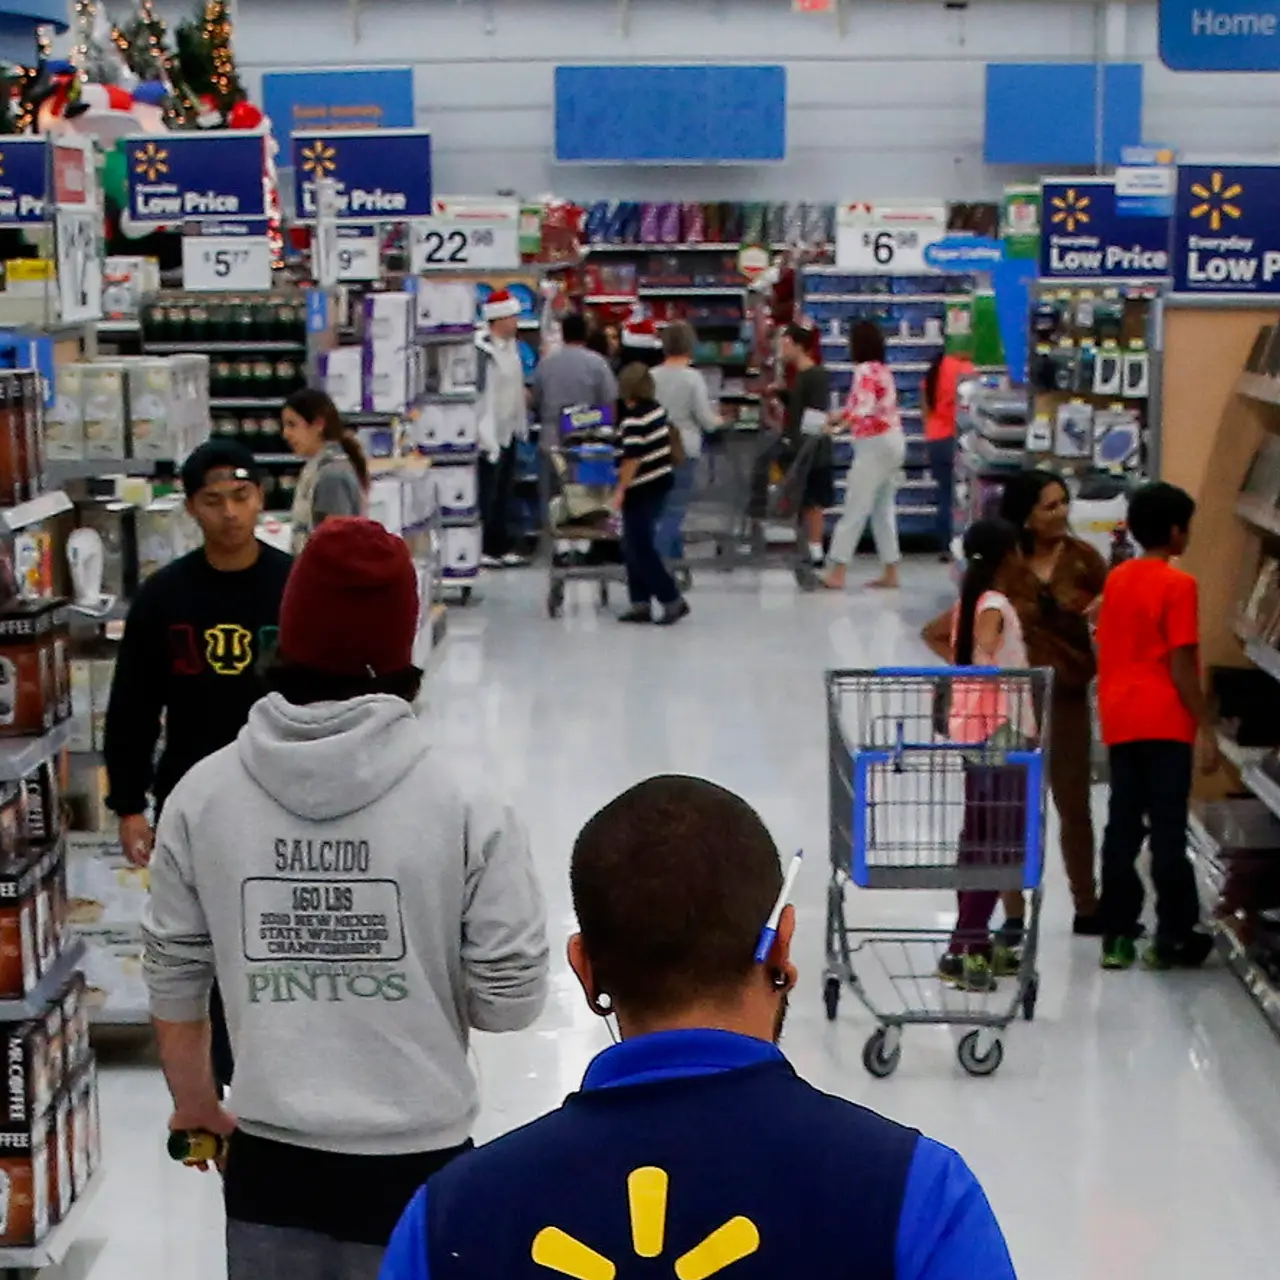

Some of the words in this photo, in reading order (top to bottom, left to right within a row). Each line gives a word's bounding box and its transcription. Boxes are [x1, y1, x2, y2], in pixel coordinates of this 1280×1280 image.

[1192, 9, 1276, 36] Home
[1049, 248, 1102, 271] Low
[1105, 245, 1168, 270] Price
[1187, 251, 1257, 282] Low
[274, 838, 370, 873] SALCIDO
[259, 927, 303, 940] STATE
[294, 914, 332, 927] NEW
[335, 914, 387, 927] MEXICO
[245, 972, 409, 1003] PINTOS
